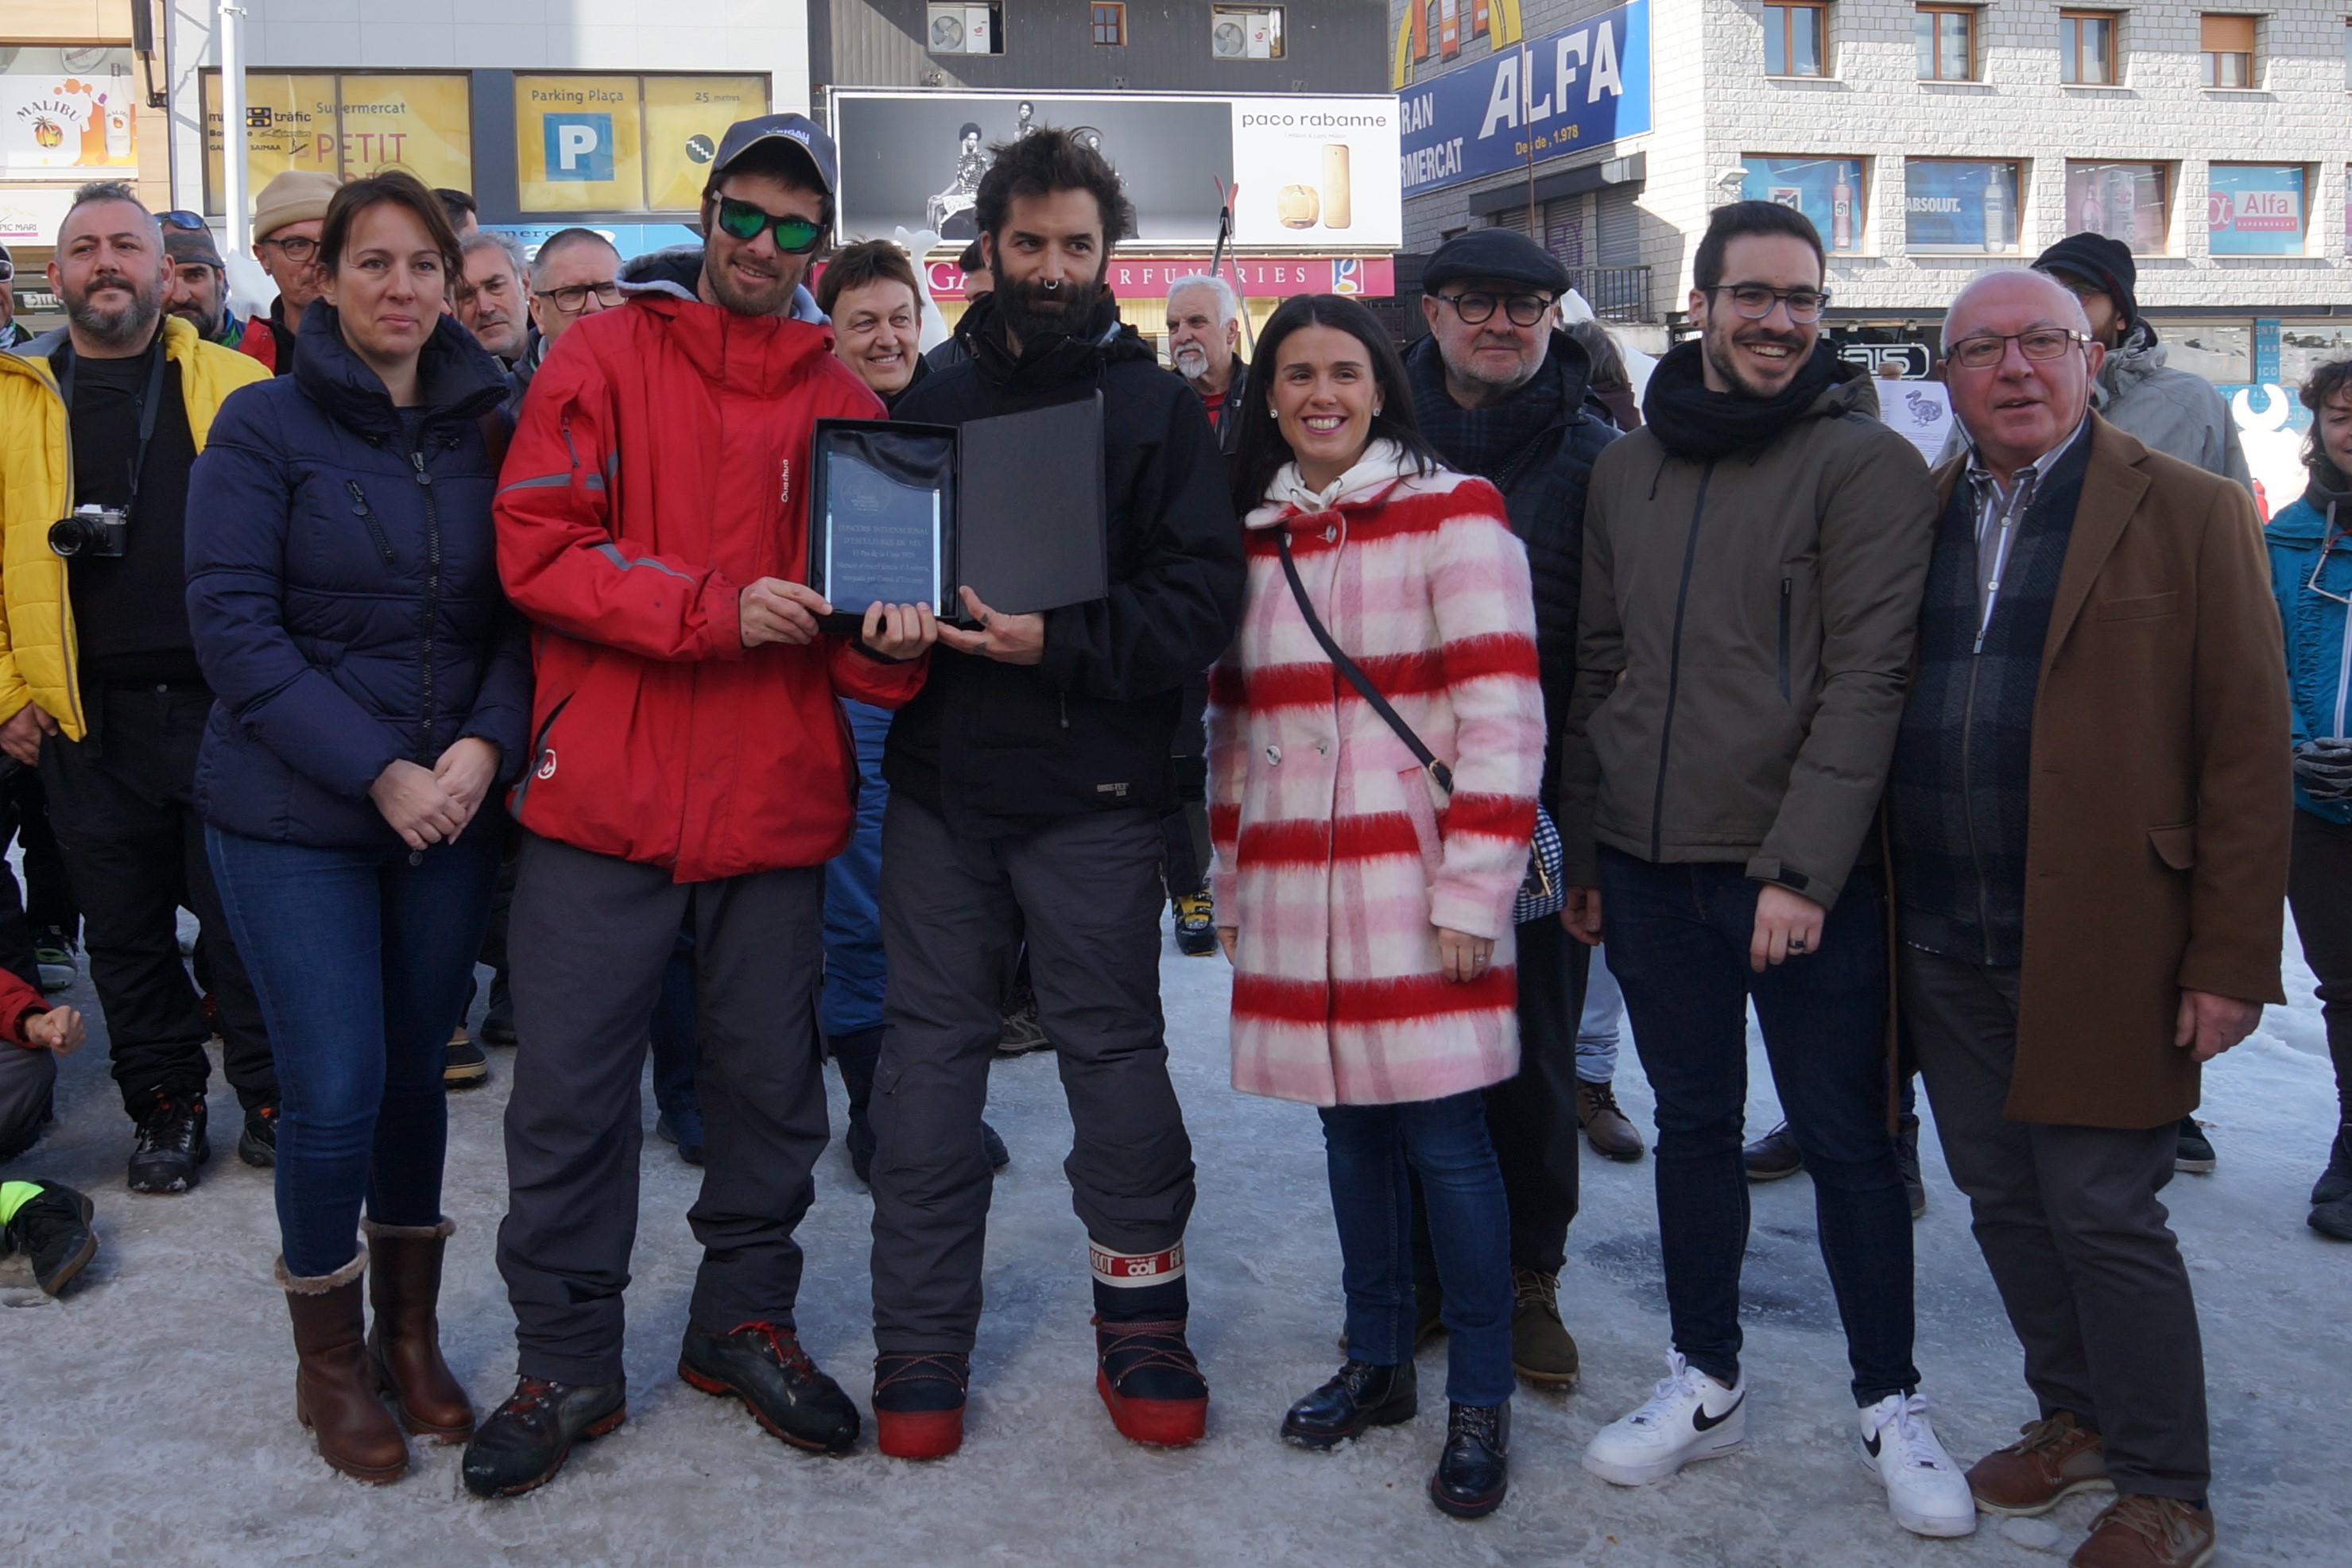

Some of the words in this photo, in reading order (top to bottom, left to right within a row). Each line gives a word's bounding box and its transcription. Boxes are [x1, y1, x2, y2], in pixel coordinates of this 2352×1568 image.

[1478, 20, 1623, 140] ALFA
[532, 90, 583, 104] Parking
[588, 90, 624, 104] Plaça
[695, 91, 709, 103] 25
[16, 100, 81, 122] MALIBU
[274, 111, 311, 122] tràfic
[1242, 114, 1294, 127] paco
[1300, 113, 1386, 127] rabanne
[1401, 93, 1433, 135] RAN
[316, 134, 407, 163] PETIT
[559, 125, 597, 169] P
[1836, 202, 1848, 215] 51
[2244, 193, 2288, 215] Alfa
